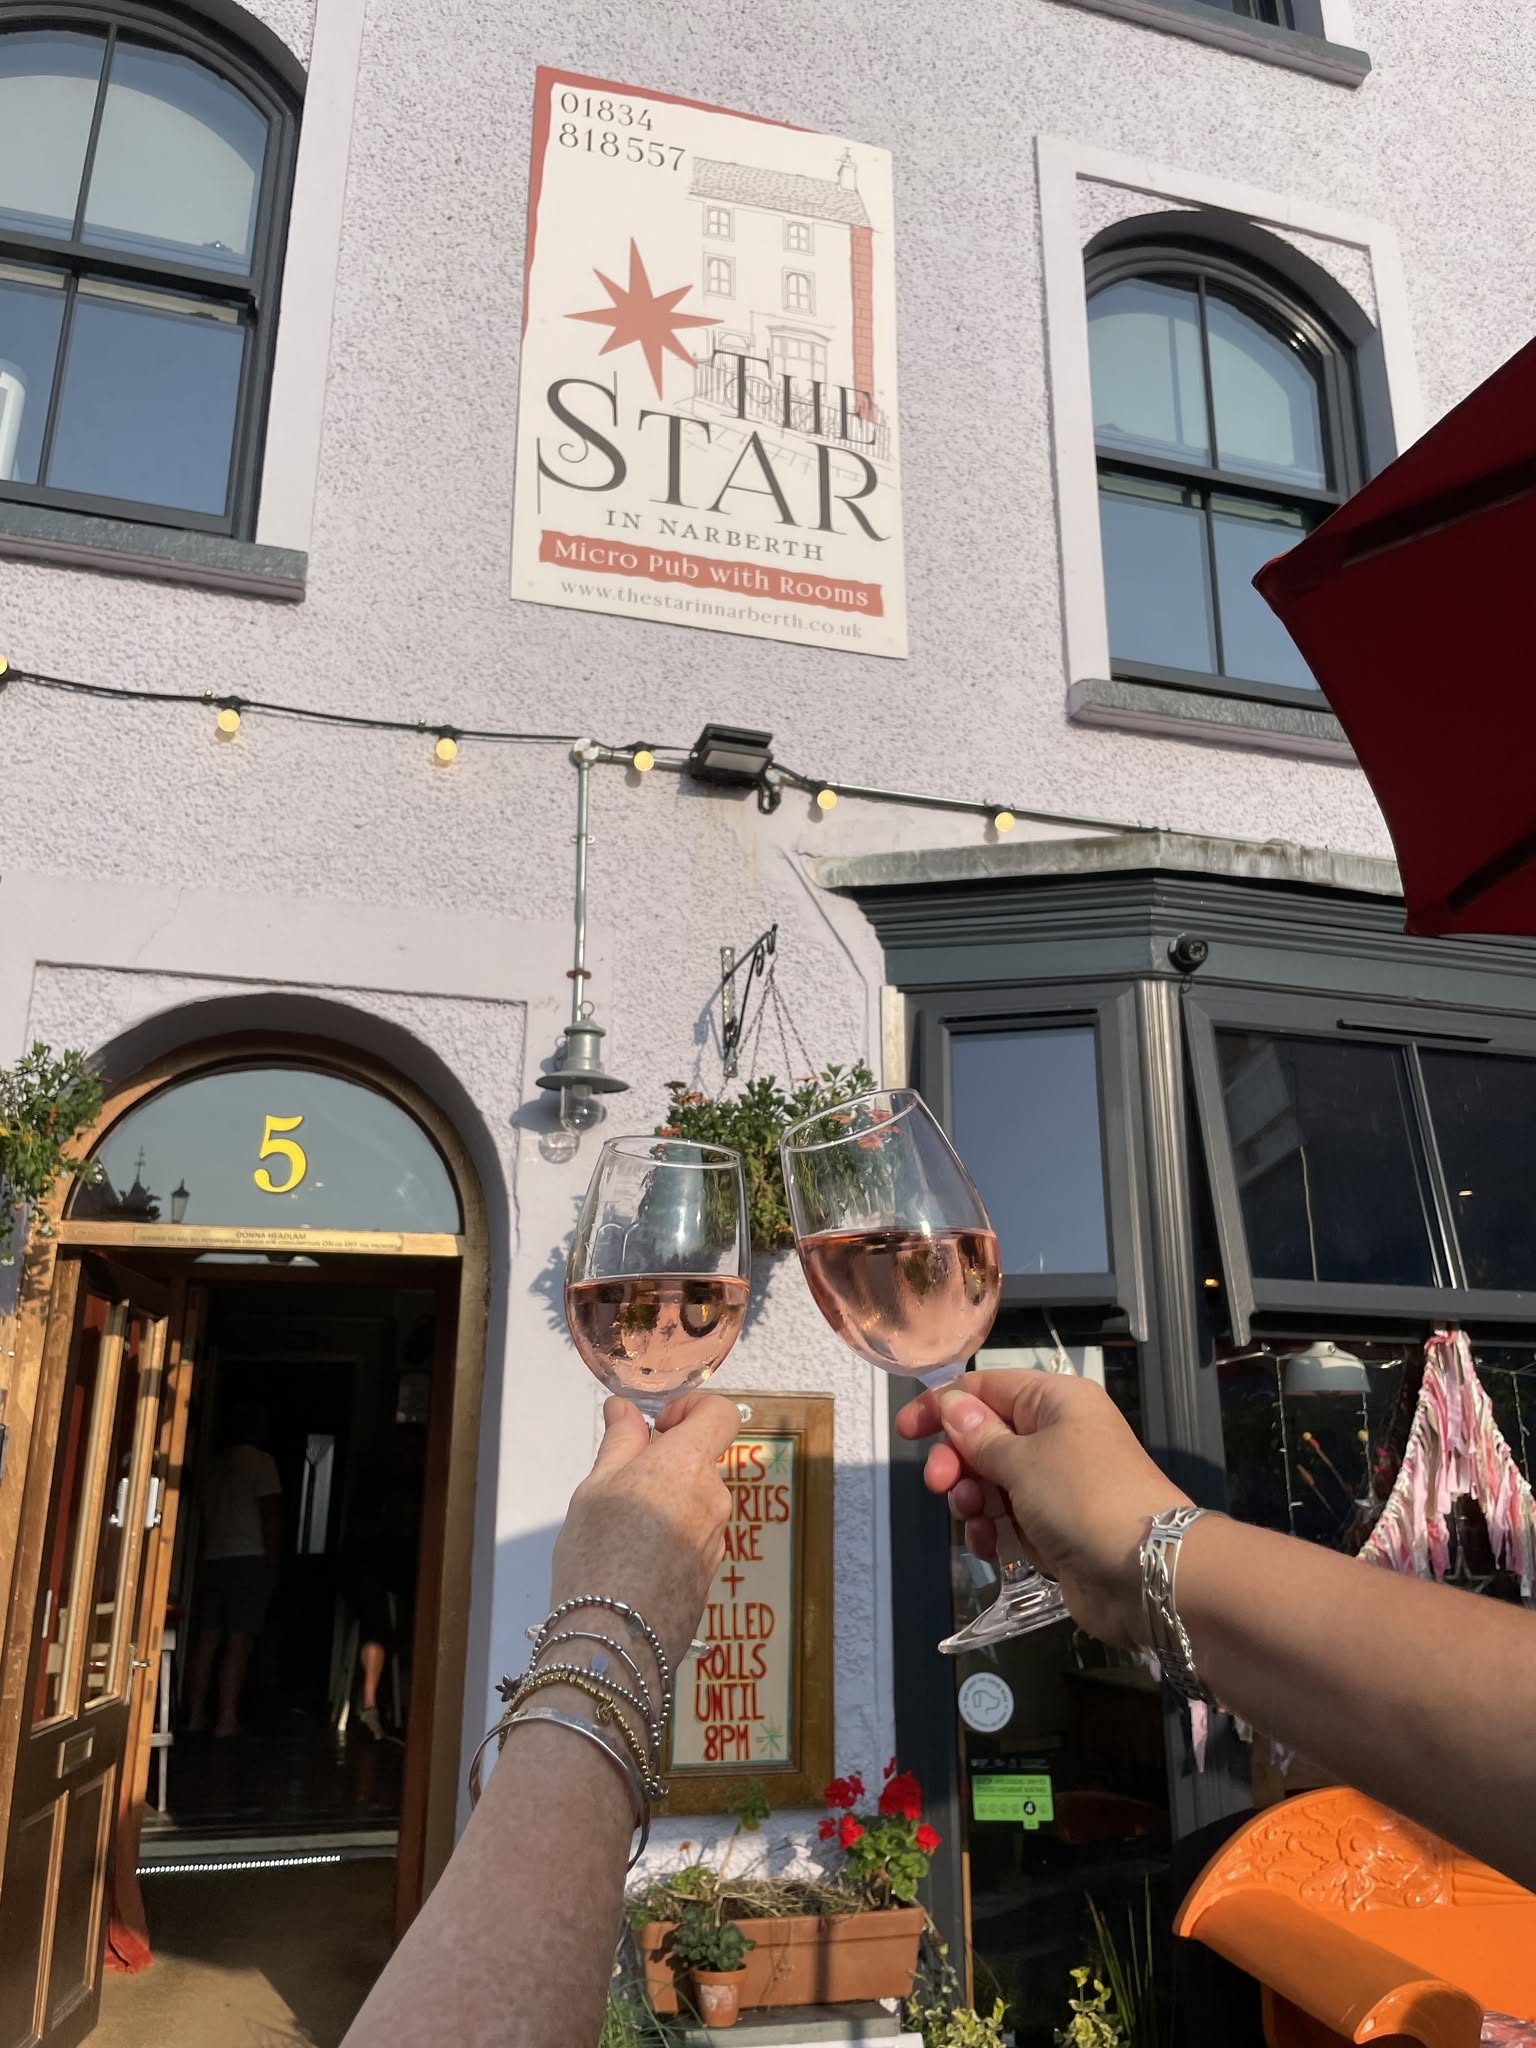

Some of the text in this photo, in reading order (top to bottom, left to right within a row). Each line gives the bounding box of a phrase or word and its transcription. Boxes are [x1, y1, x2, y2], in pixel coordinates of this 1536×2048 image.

[560, 91, 653, 132] 01834
[558, 121, 687, 172] 818557
[710, 349, 877, 446] THE
[536, 370, 892, 542] STAR
[605, 510, 824, 561] IN NARBERTH
[554, 539, 870, 607] Micro Pub with Rooms
[560, 580, 863, 639] www.thestarinnarberth.co.uk
[253, 1113, 308, 1194] 5
[695, 1682, 765, 1723] UNTIL
[703, 1723, 750, 1762] 8PM
